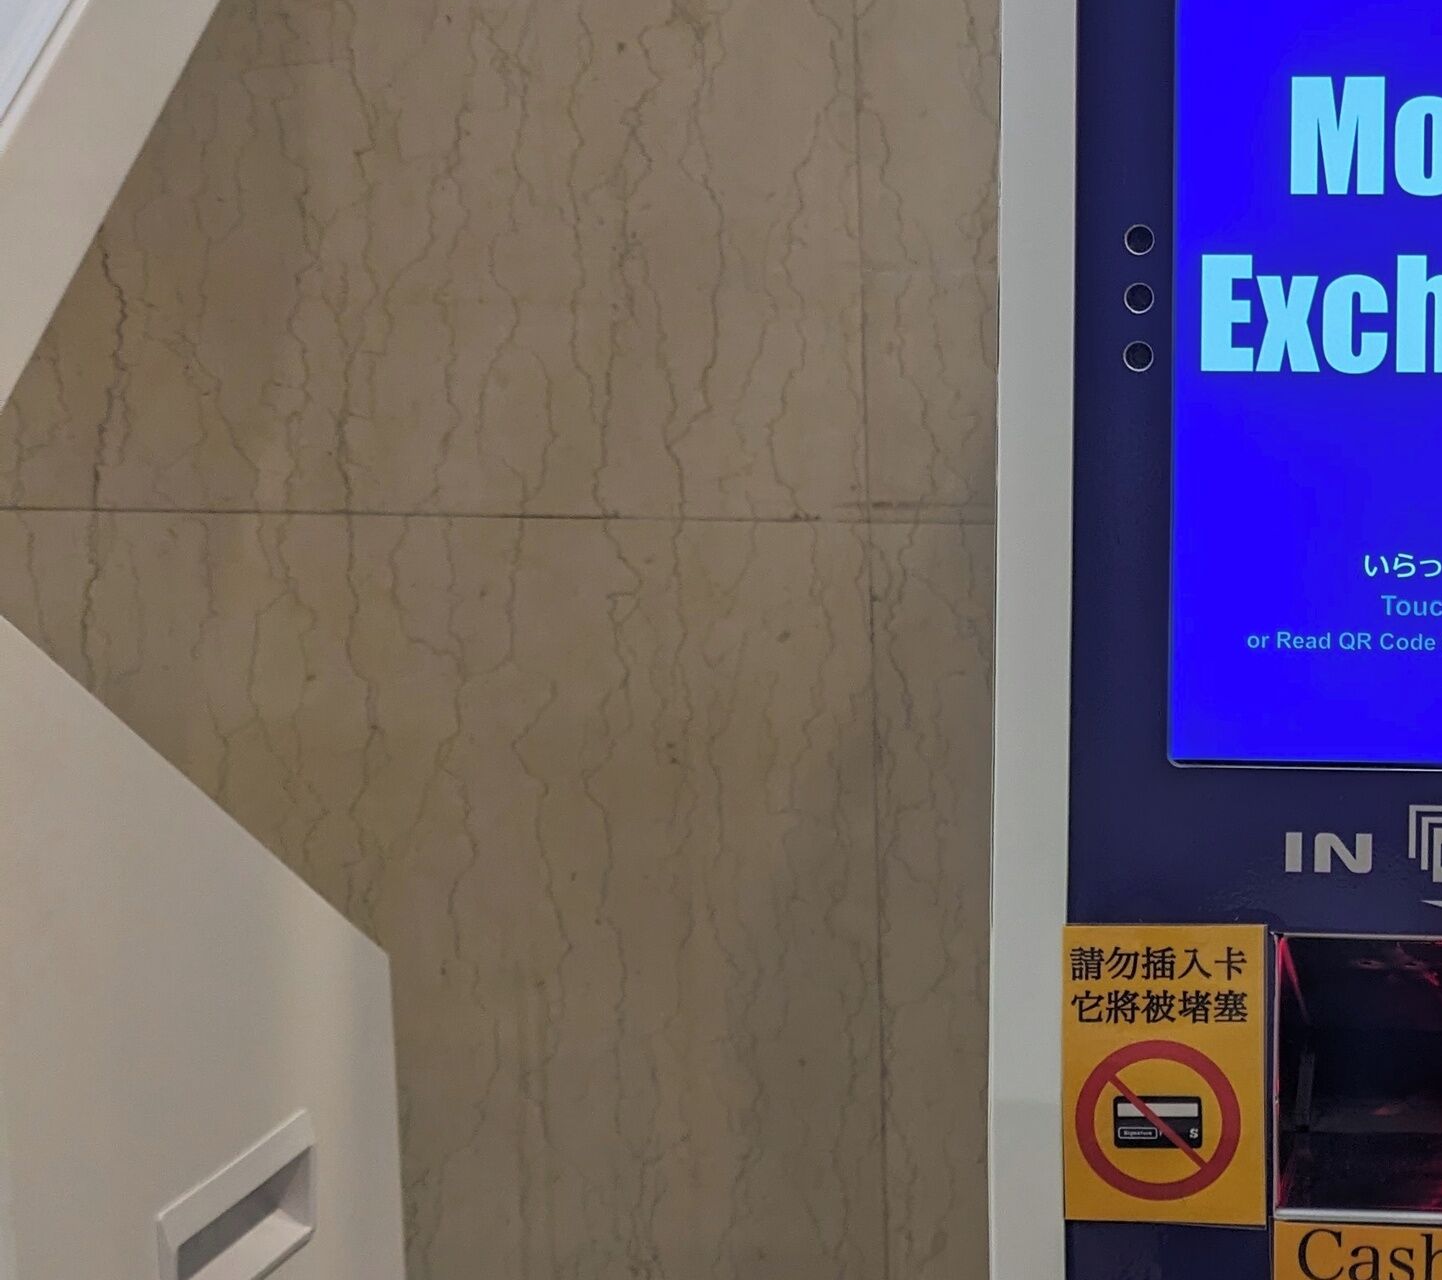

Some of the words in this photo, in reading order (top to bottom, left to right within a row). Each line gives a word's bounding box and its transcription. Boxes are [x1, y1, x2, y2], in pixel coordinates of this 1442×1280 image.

[1246, 634, 1271, 651] or
[1276, 630, 1332, 652] Read
[1338, 631, 1373, 654] QR
[1379, 632, 1436, 653] Code
[1285, 832, 1373, 874] IN
[1069, 944, 1249, 982] 請勿插入卡
[1070, 989, 1249, 1025] 它將被堵塞
